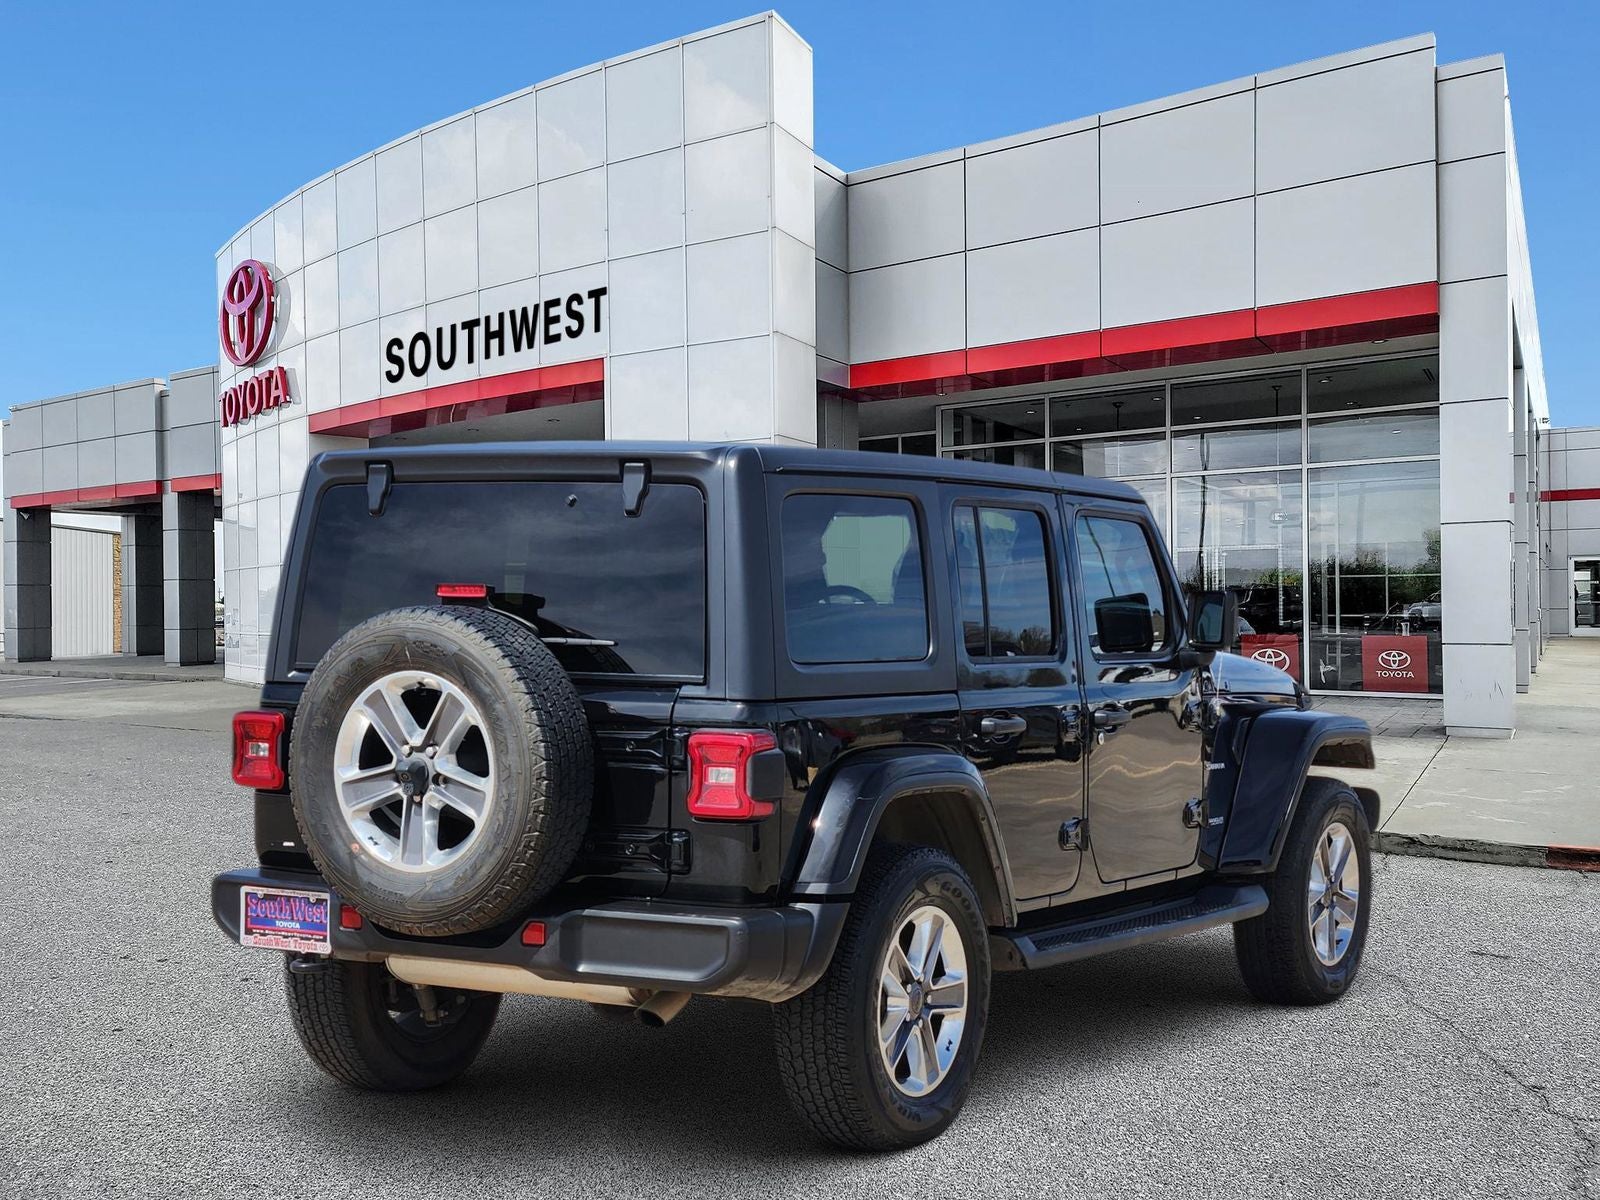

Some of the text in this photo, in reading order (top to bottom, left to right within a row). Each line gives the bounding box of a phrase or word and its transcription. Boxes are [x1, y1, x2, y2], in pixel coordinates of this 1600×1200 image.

[385, 286, 608, 384] SOUTHWEST
[218, 366, 291, 428] TOYOTA
[1375, 670, 1415, 678] TOYOTA
[276, 920, 300, 929] TOYOTA
